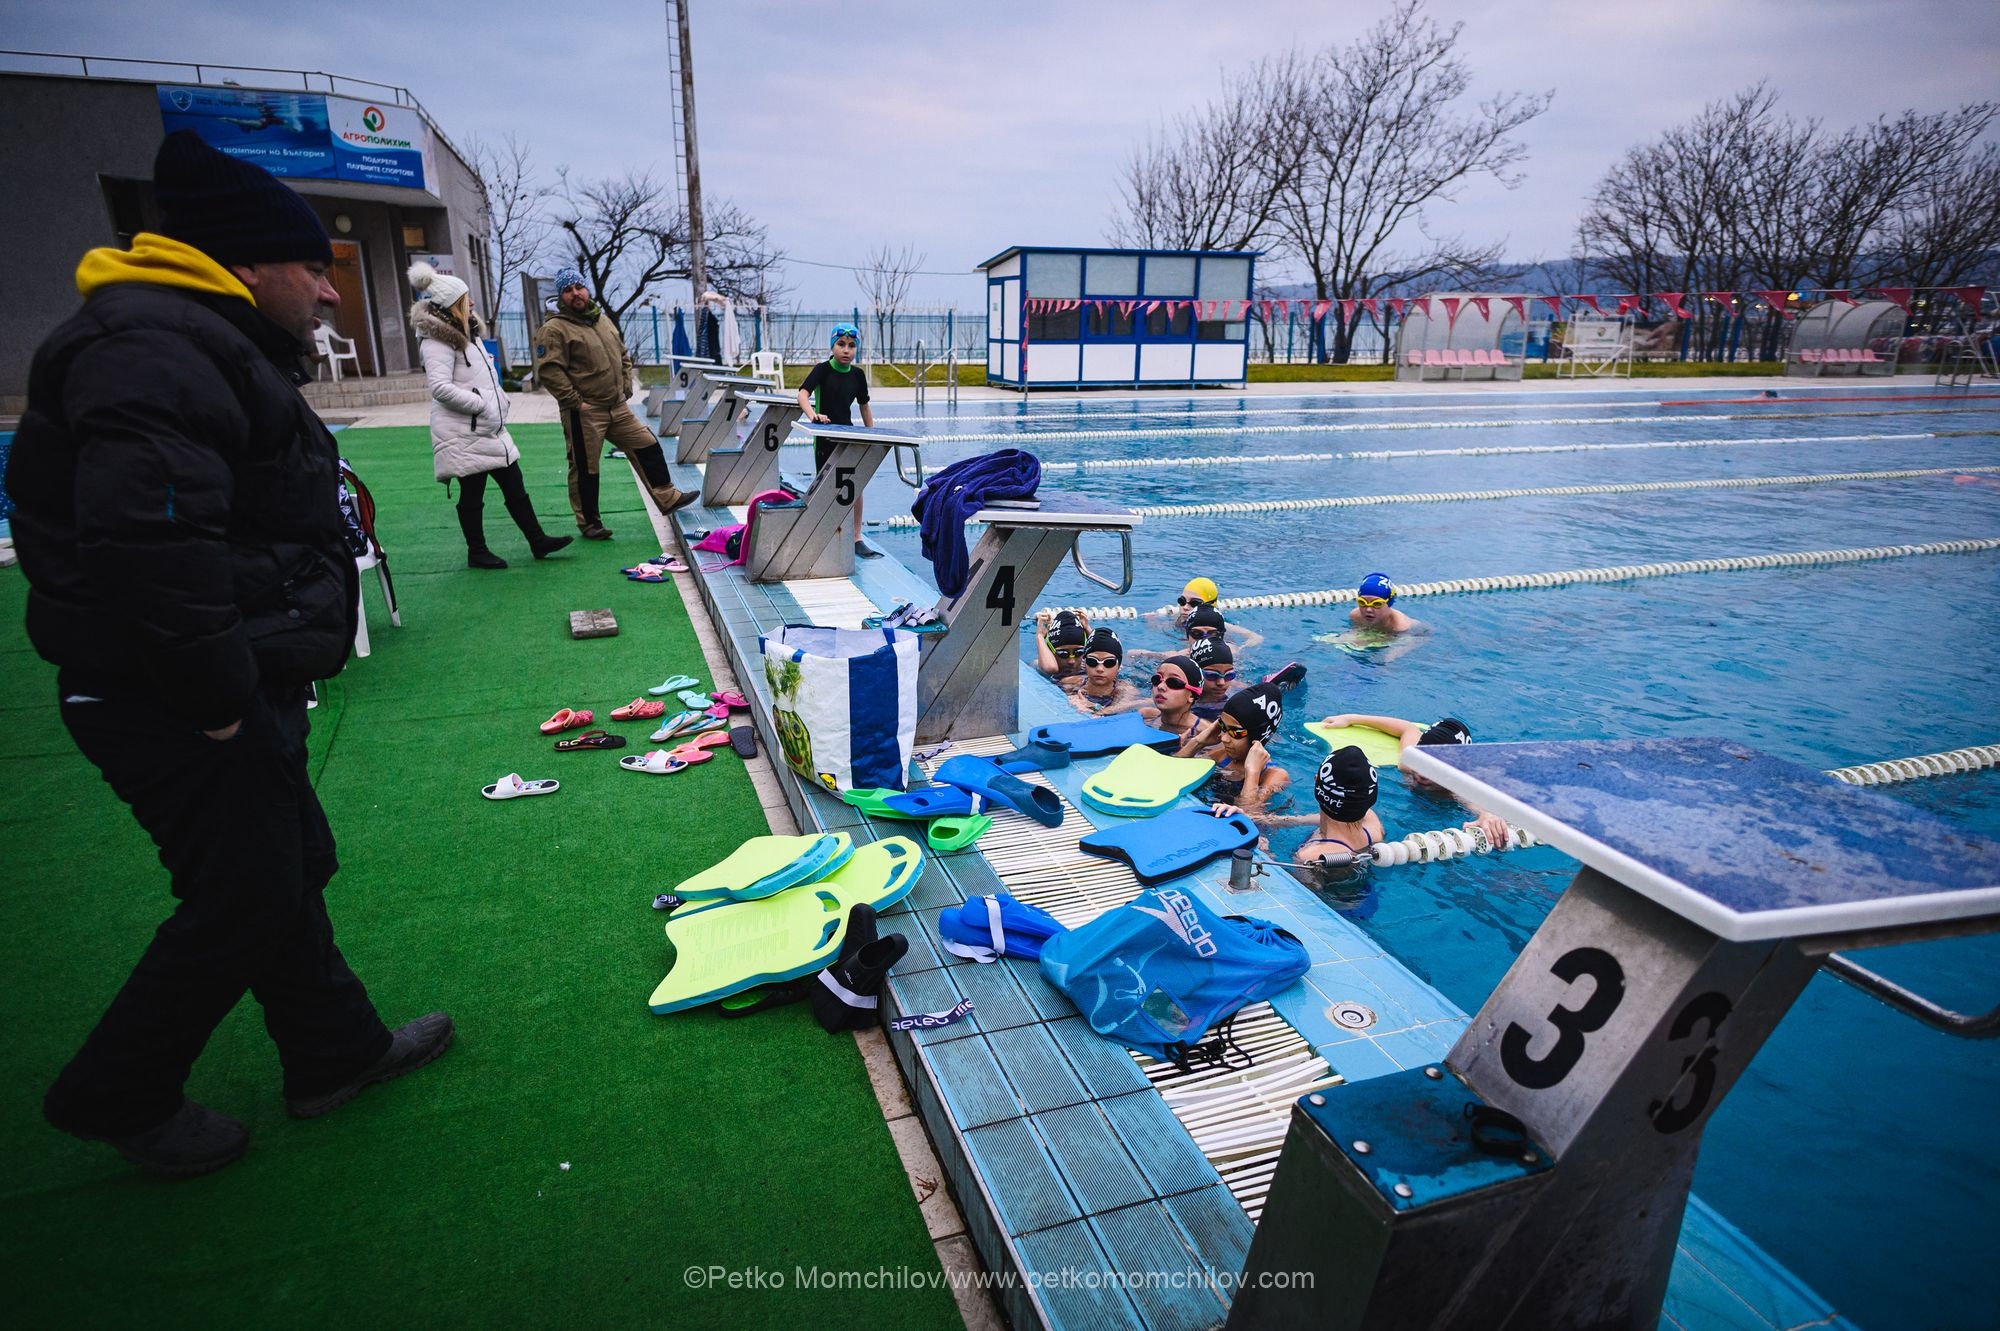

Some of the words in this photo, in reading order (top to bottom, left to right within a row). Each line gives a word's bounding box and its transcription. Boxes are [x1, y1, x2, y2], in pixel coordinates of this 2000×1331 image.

[343, 132, 411, 148] АГРОПОЛИХИМ
[680, 372, 688, 388] 9
[725, 399, 737, 421] 7
[764, 423, 779, 452] 6
[835, 467, 855, 506] 5
[986, 566, 1015, 626] 4
[1192, 638, 1212, 651] UA
[1150, 889, 1217, 958] peedo
[1500, 946, 1626, 1089] 3
[1648, 991, 1733, 1134] 3
